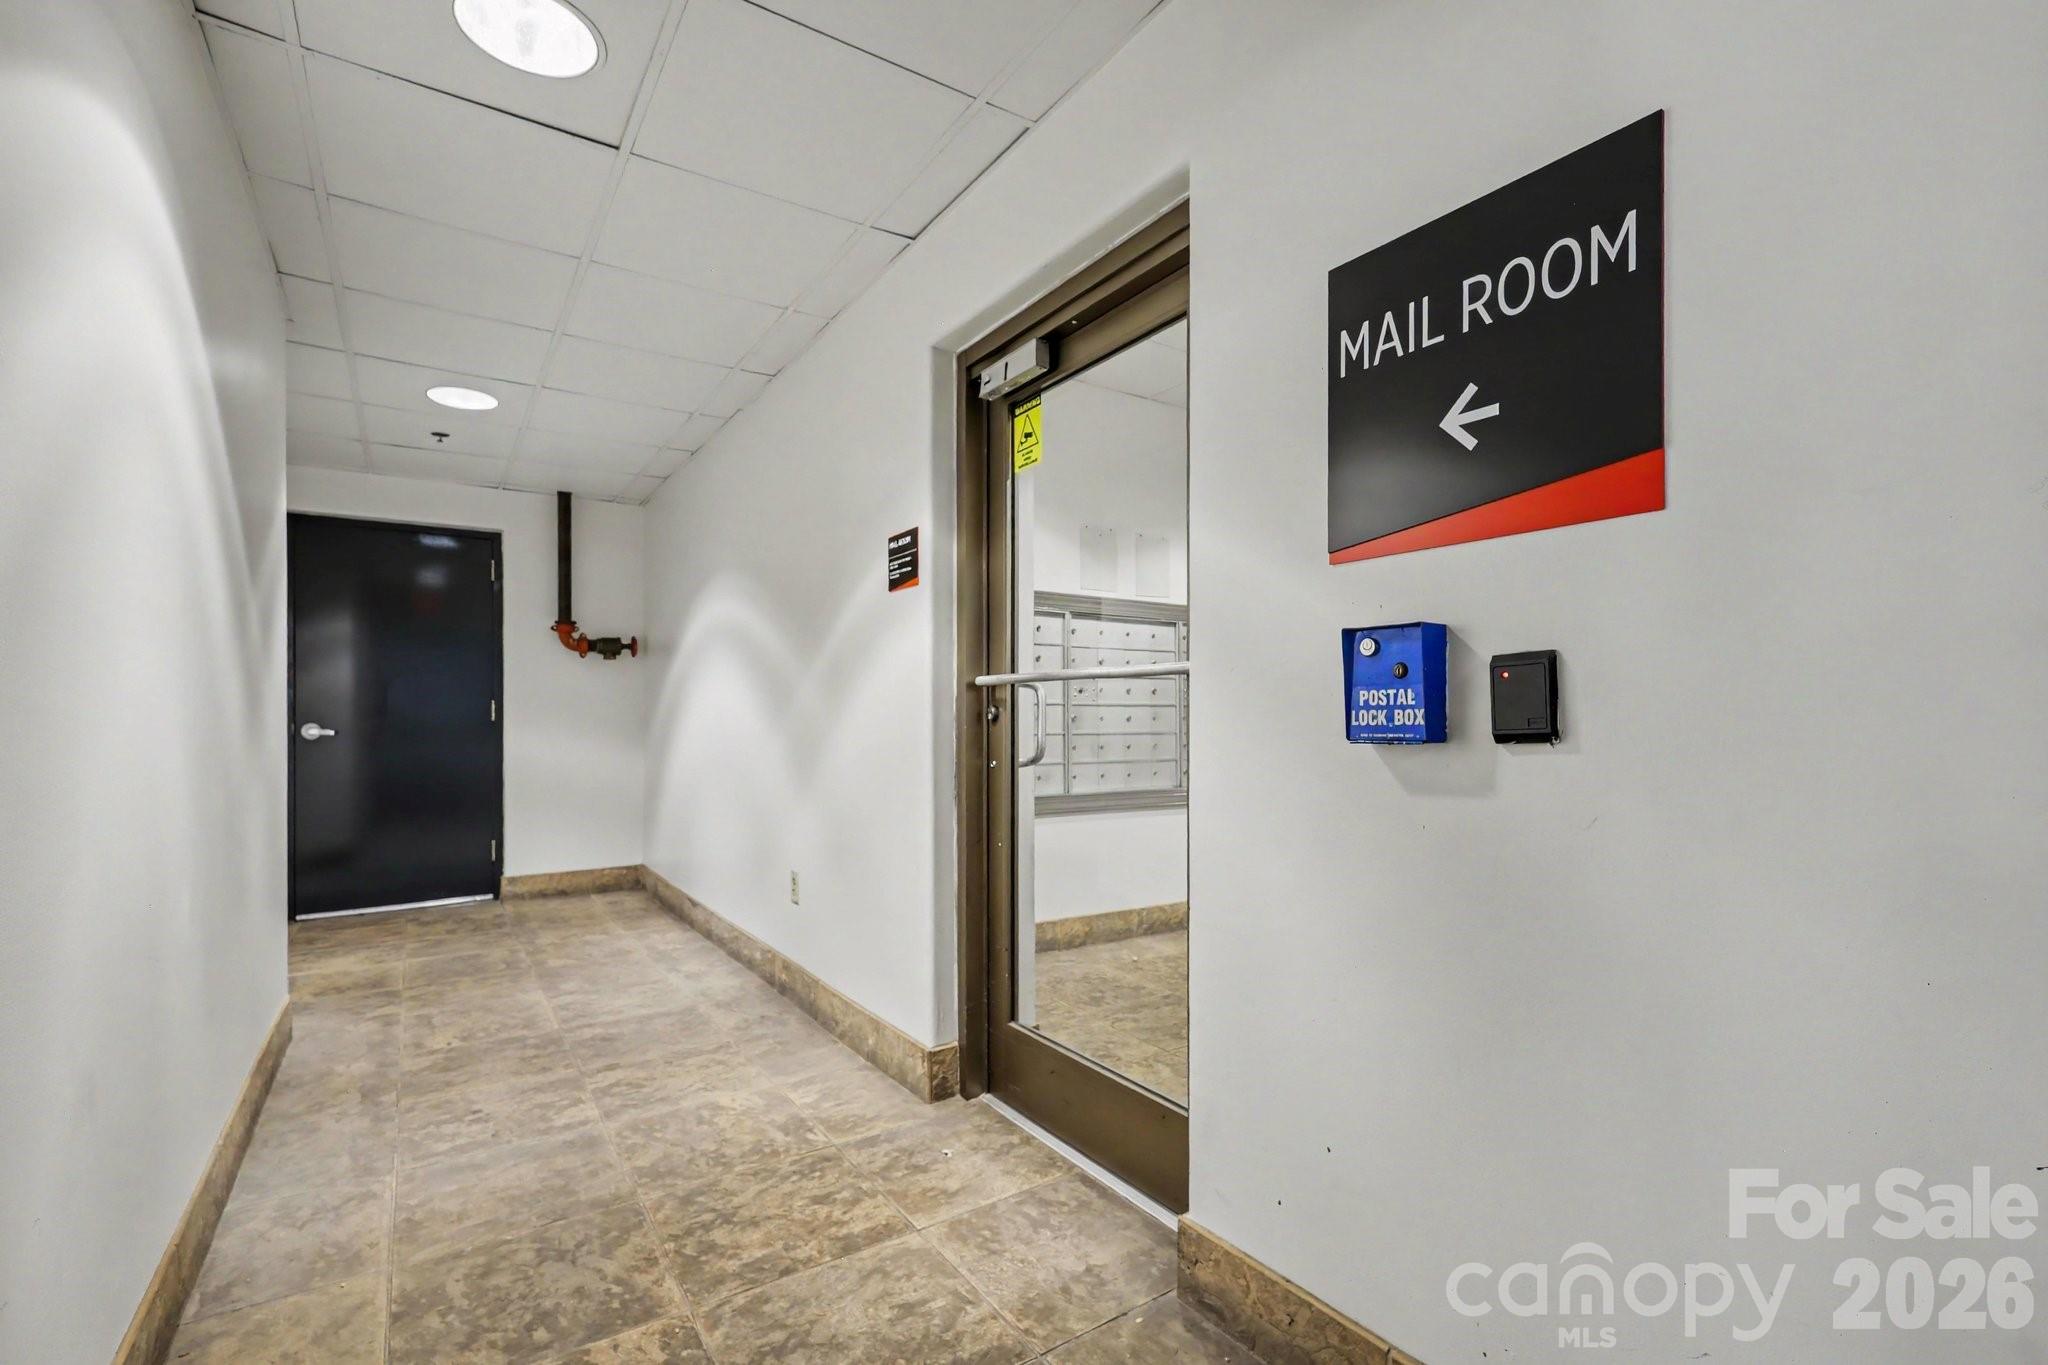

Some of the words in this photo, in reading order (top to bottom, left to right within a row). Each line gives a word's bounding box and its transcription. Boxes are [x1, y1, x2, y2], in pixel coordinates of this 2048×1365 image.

[1340, 296, 1445, 378] MAIL
[1462, 209, 1638, 333] ROOM
[1360, 688, 1416, 706] POSTAL
[1352, 709, 1387, 726] LOCK
[1394, 708, 1425, 725] BOX
